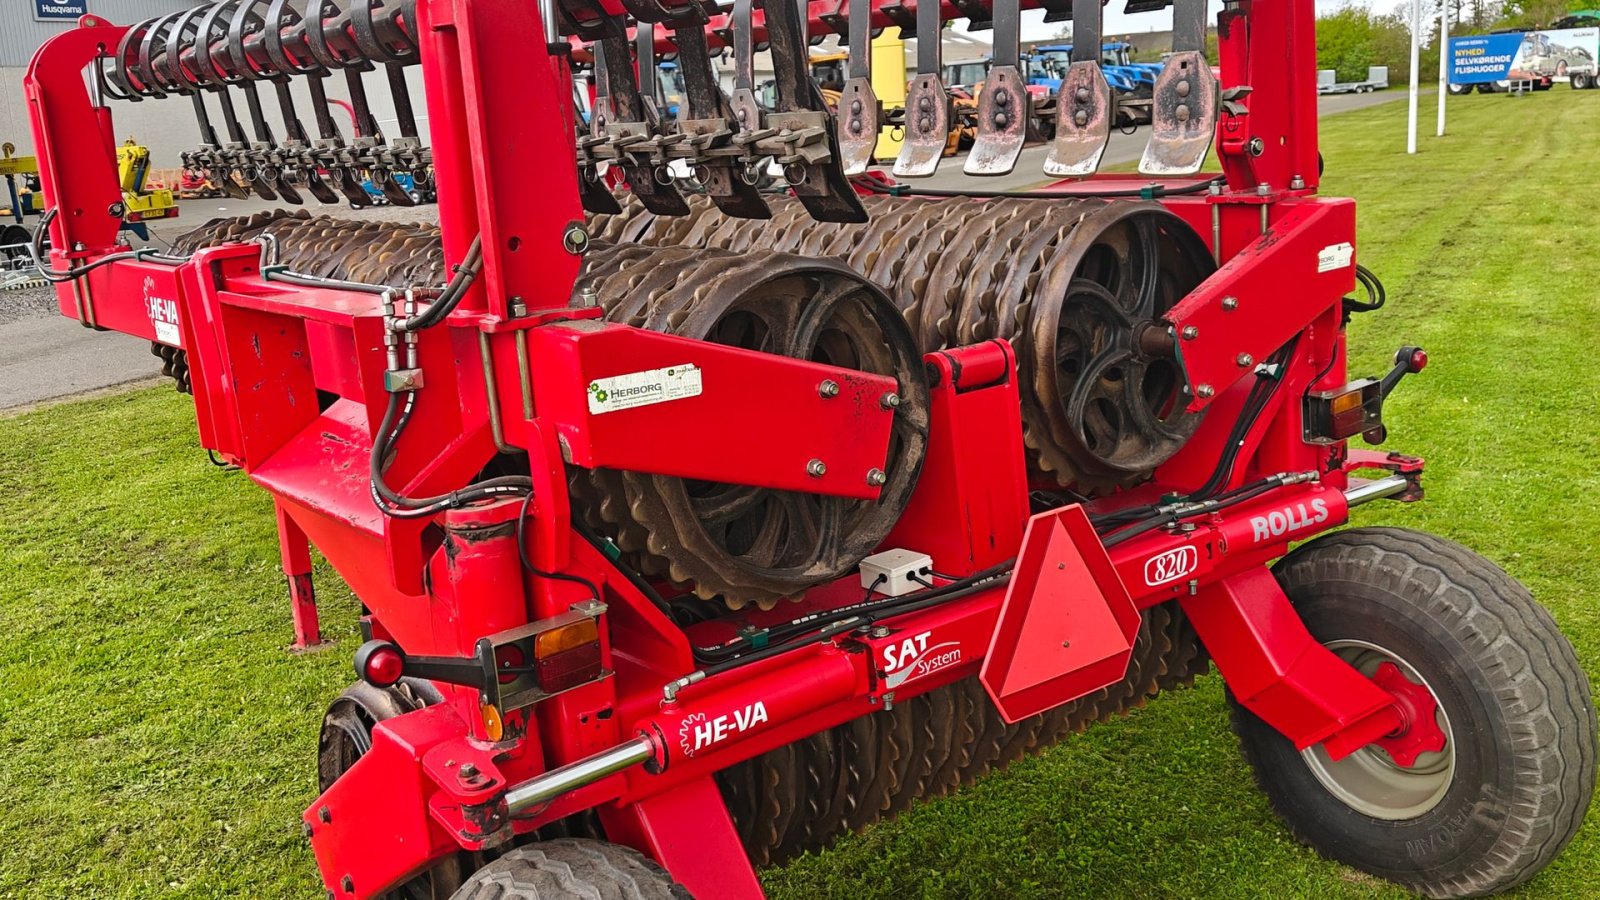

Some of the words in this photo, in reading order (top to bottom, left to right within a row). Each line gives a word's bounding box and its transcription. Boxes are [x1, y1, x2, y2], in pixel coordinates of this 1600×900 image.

[41, 4, 83, 14] Husqvarna
[1455, 48, 1485, 56] NYHED!
[1455, 55, 1512, 66] SELVKØRENDE
[1455, 64, 1506, 74] FLISHUGGER
[150, 296, 180, 325] HE-VA
[610, 383, 662, 399] HERBORG
[1250, 498, 1328, 542] ROLLS
[1154, 549, 1188, 582] 820
[884, 631, 932, 672] SAT
[917, 648, 961, 676] System
[694, 701, 768, 751] HE-VA
